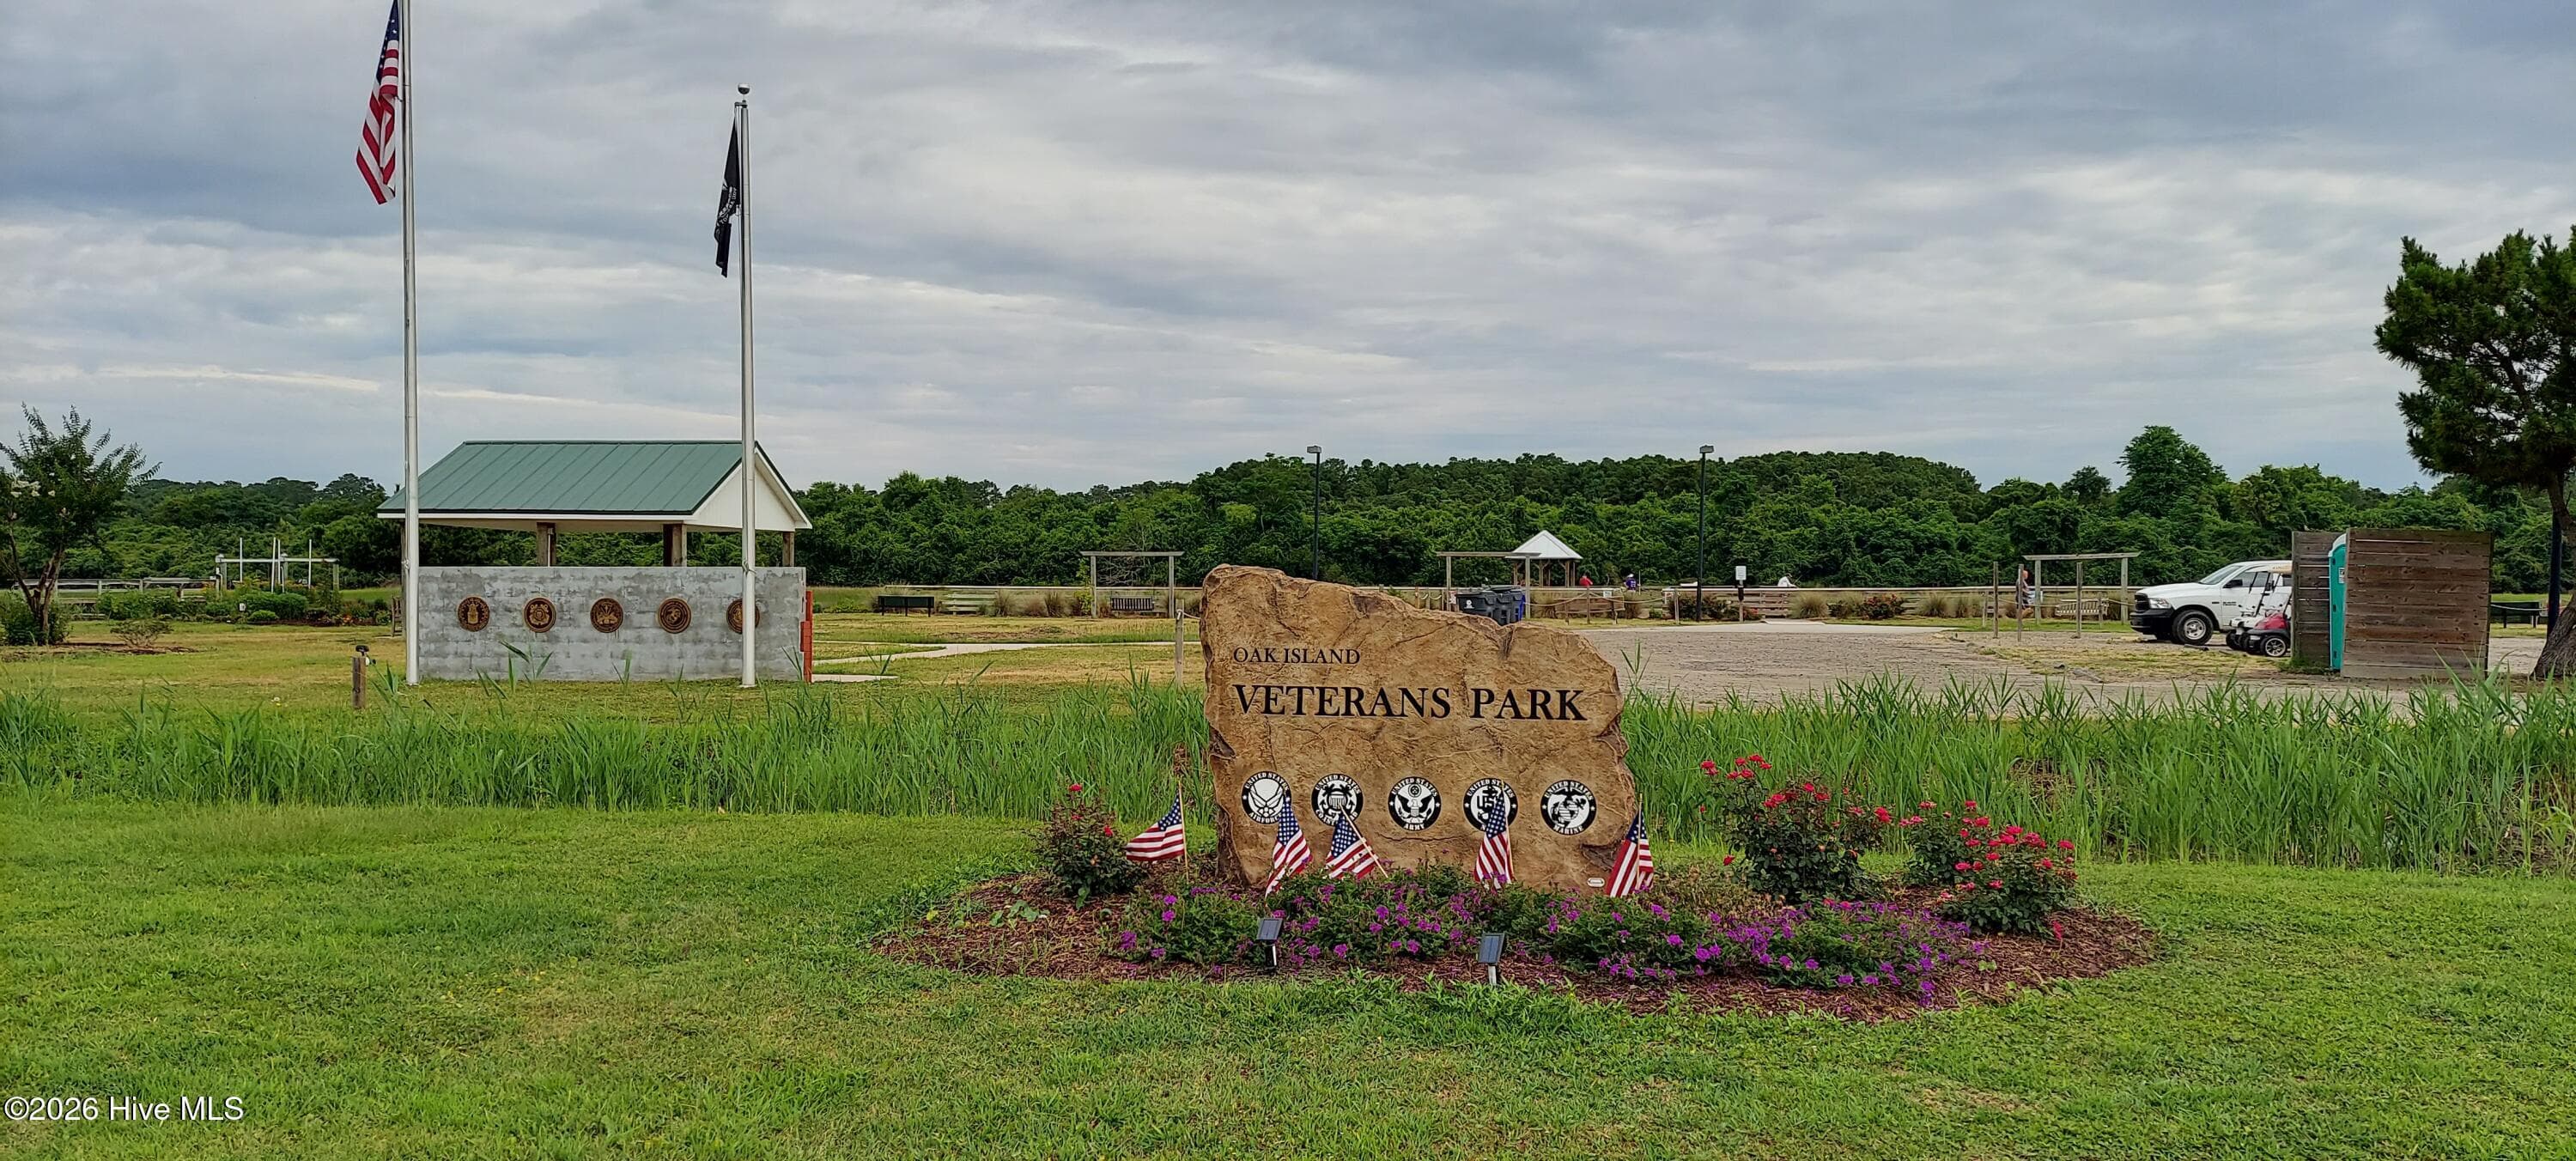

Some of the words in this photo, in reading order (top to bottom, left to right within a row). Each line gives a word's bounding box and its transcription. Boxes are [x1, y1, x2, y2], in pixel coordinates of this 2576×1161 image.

[1233, 647, 1280, 663] OAK
[1283, 647, 1361, 665] ISLAND
[1232, 684, 1451, 719] VETERANS
[1469, 688, 1588, 721] PARK
[1244, 772, 1267, 789] UNITED
[1315, 775, 1338, 790] UNITED
[1340, 775, 1362, 794] STATES
[1391, 777, 1414, 795] UNITED
[1416, 778, 1437, 797] STATES
[1467, 779, 1490, 796] UNITED
[1544, 781, 1568, 799] UNITED
[1570, 781, 1594, 800] STATES
[1403, 823, 1425, 831] ARMY
[1552, 824, 1583, 835] MARINE
